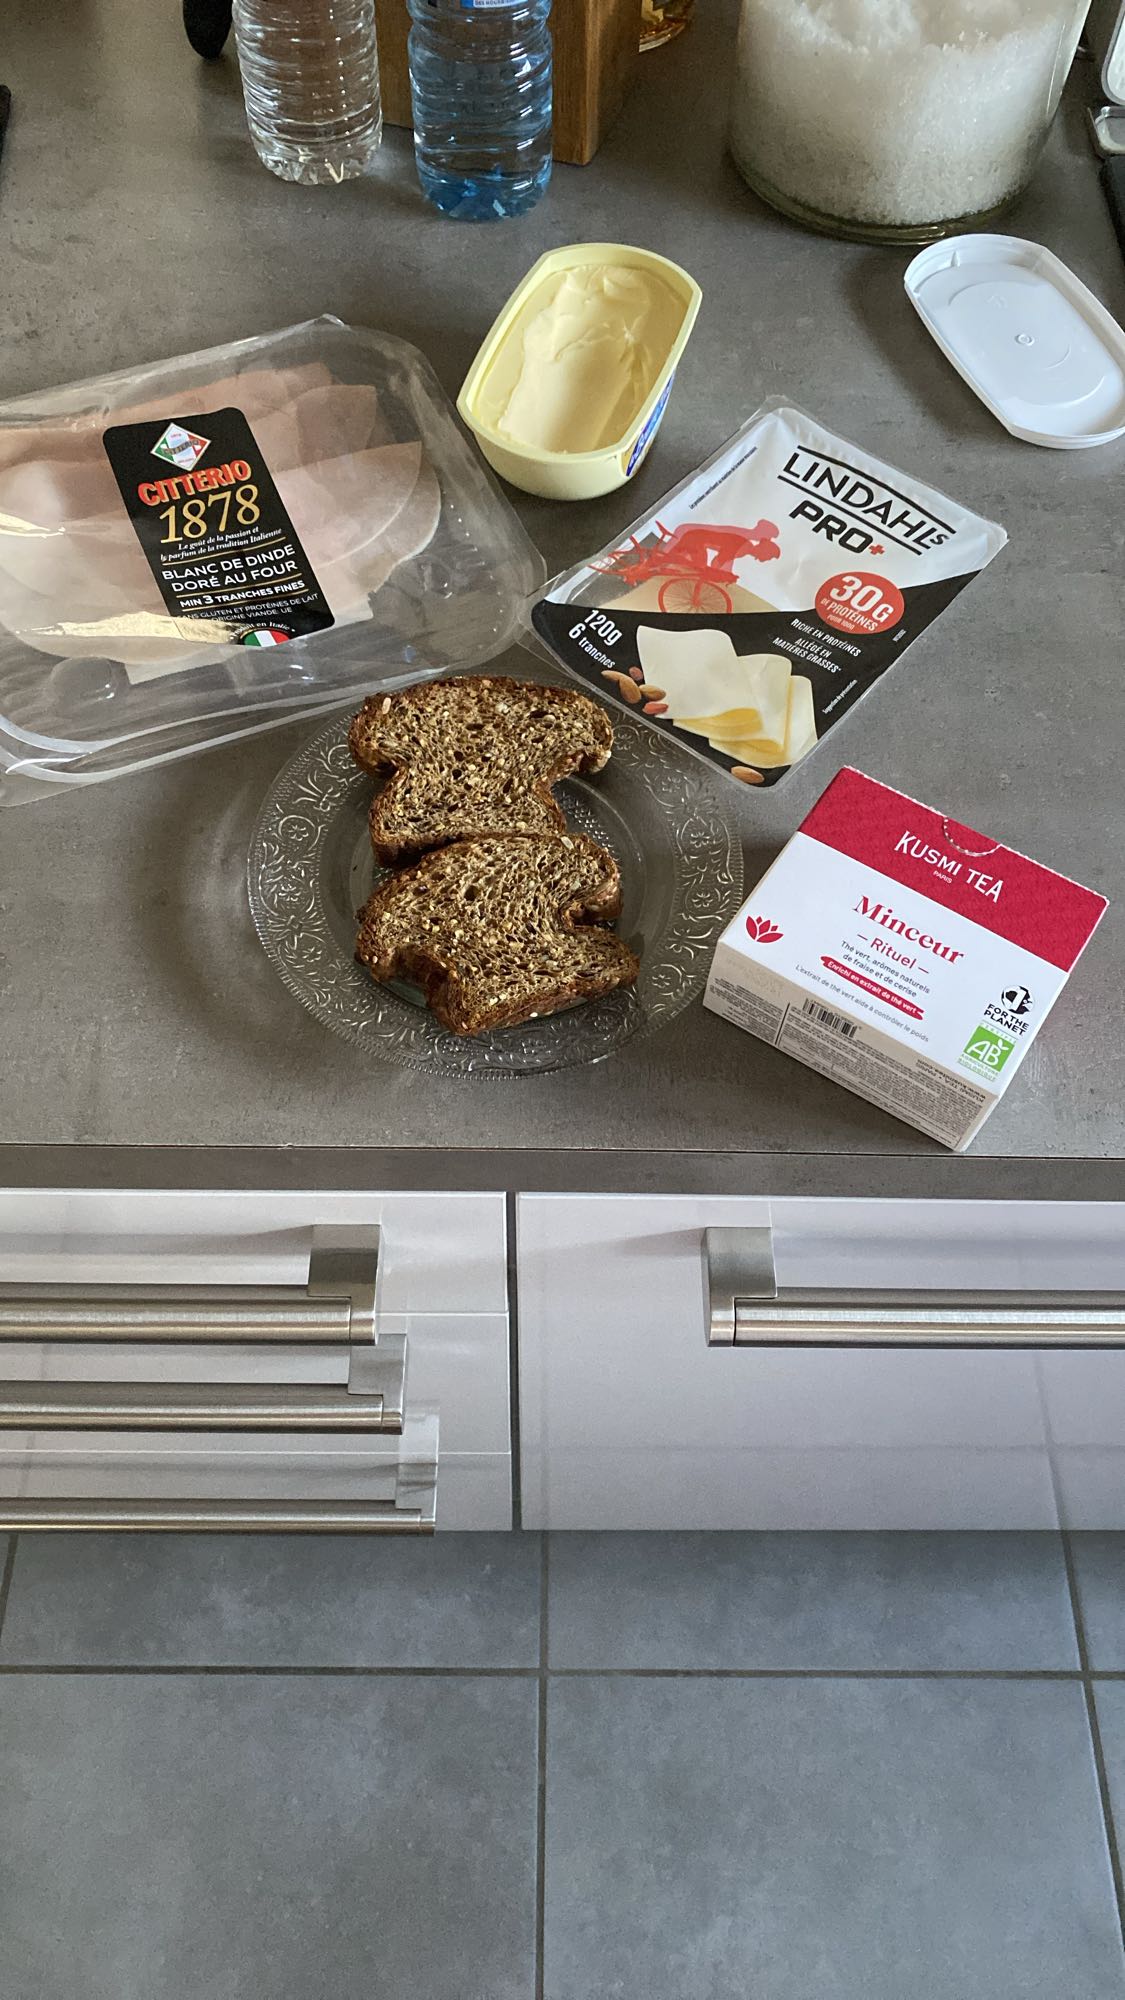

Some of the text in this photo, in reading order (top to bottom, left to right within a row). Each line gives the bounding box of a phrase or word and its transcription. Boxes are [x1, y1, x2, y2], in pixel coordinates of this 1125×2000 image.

[137, 460, 252, 506] CITTERIO
[160, 484, 260, 543] 1878
[168, 550, 197, 563] parfum
[198, 546, 207, 554] de
[207, 544, 215, 552] la
[216, 538, 249, 550] tradition
[250, 528, 282, 544] Italienne
[178, 543, 188, 551] Le
[207, 536, 216, 545] de
[216, 534, 224, 542] la
[225, 529, 251, 542] passion
[162, 544, 295, 580] BLANC DE DINDE
[172, 560, 298, 592] DORÉ AU FOUR
[180, 580, 305, 608] MIN 3 TRANCHES FINES
[200, 608, 233, 618] GLUTEN
[245, 600, 289, 611] PROTÉINES
[290, 598, 302, 606] DE
[302, 593, 319, 603] LAIT
[269, 621, 290, 631] Italie
[584, 609, 622, 646] 120g
[827, 600, 878, 632] PROTÉINES
[569, 623, 616, 669] 6 tranches
[772, 637, 809, 658] MATIÈRES
[791, 618, 861, 657] RICHE EN PROTÉINES
[794, 638, 832, 658] ALLÉGÉ EN
[894, 830, 1003, 903] KUSMI TEA
[933, 870, 953, 884] PARIS
[852, 895, 965, 964] Minceur
[841, 940, 855, 952] Thé
[872, 958, 900, 977] arômes
[900, 973, 930, 994] naturels
[870, 937, 916, 969] Rituel
[827, 961, 917, 1014] Enrichi en extrait de thé vert
[843, 953, 917, 998] de fraise et de cerise
[795, 964, 821, 983] L'extrait
[821, 978, 830, 987] de
[829, 982, 841, 993] thé
[841, 990, 855, 1001] vert
[854, 997, 869, 1009] aide
[874, 1009, 905, 1028] contrôler
[904, 1024, 911, 1032] le
[910, 1029, 929, 1042] poids
[987, 1003, 1029, 1030] FOR THE
[984, 1009, 1026, 1035] PLANET
[966, 1040, 1002, 1066] AB
